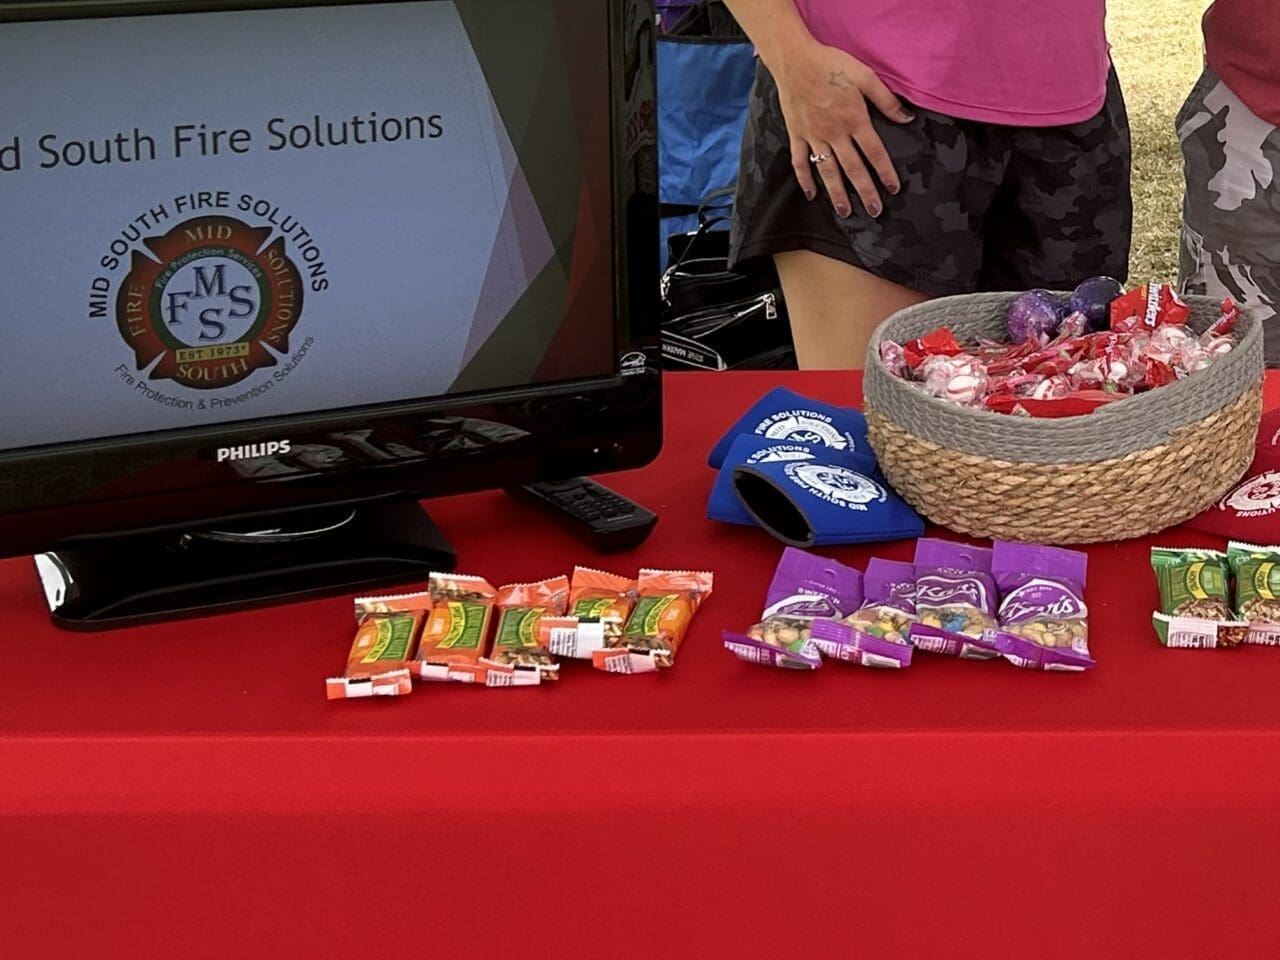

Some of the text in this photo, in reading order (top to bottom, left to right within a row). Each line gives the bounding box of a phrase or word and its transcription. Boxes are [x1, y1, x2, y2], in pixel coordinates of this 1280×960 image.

[39, 128, 157, 169] South
[174, 124, 252, 158] Fire
[267, 111, 444, 150] Solutions
[185, 224, 232, 241] MID
[89, 191, 329, 319] MID SOUTH FIRE SOLUTIONS
[265, 249, 294, 342] SOLUTIONS
[178, 349, 204, 361] EST
[114, 336, 315, 410] Fire Protection & Prevention Solutions
[176, 357, 248, 382] SOUTH
[771, 410, 832, 423] SOLUTIONS
[217, 440, 291, 462] PHILIPS
